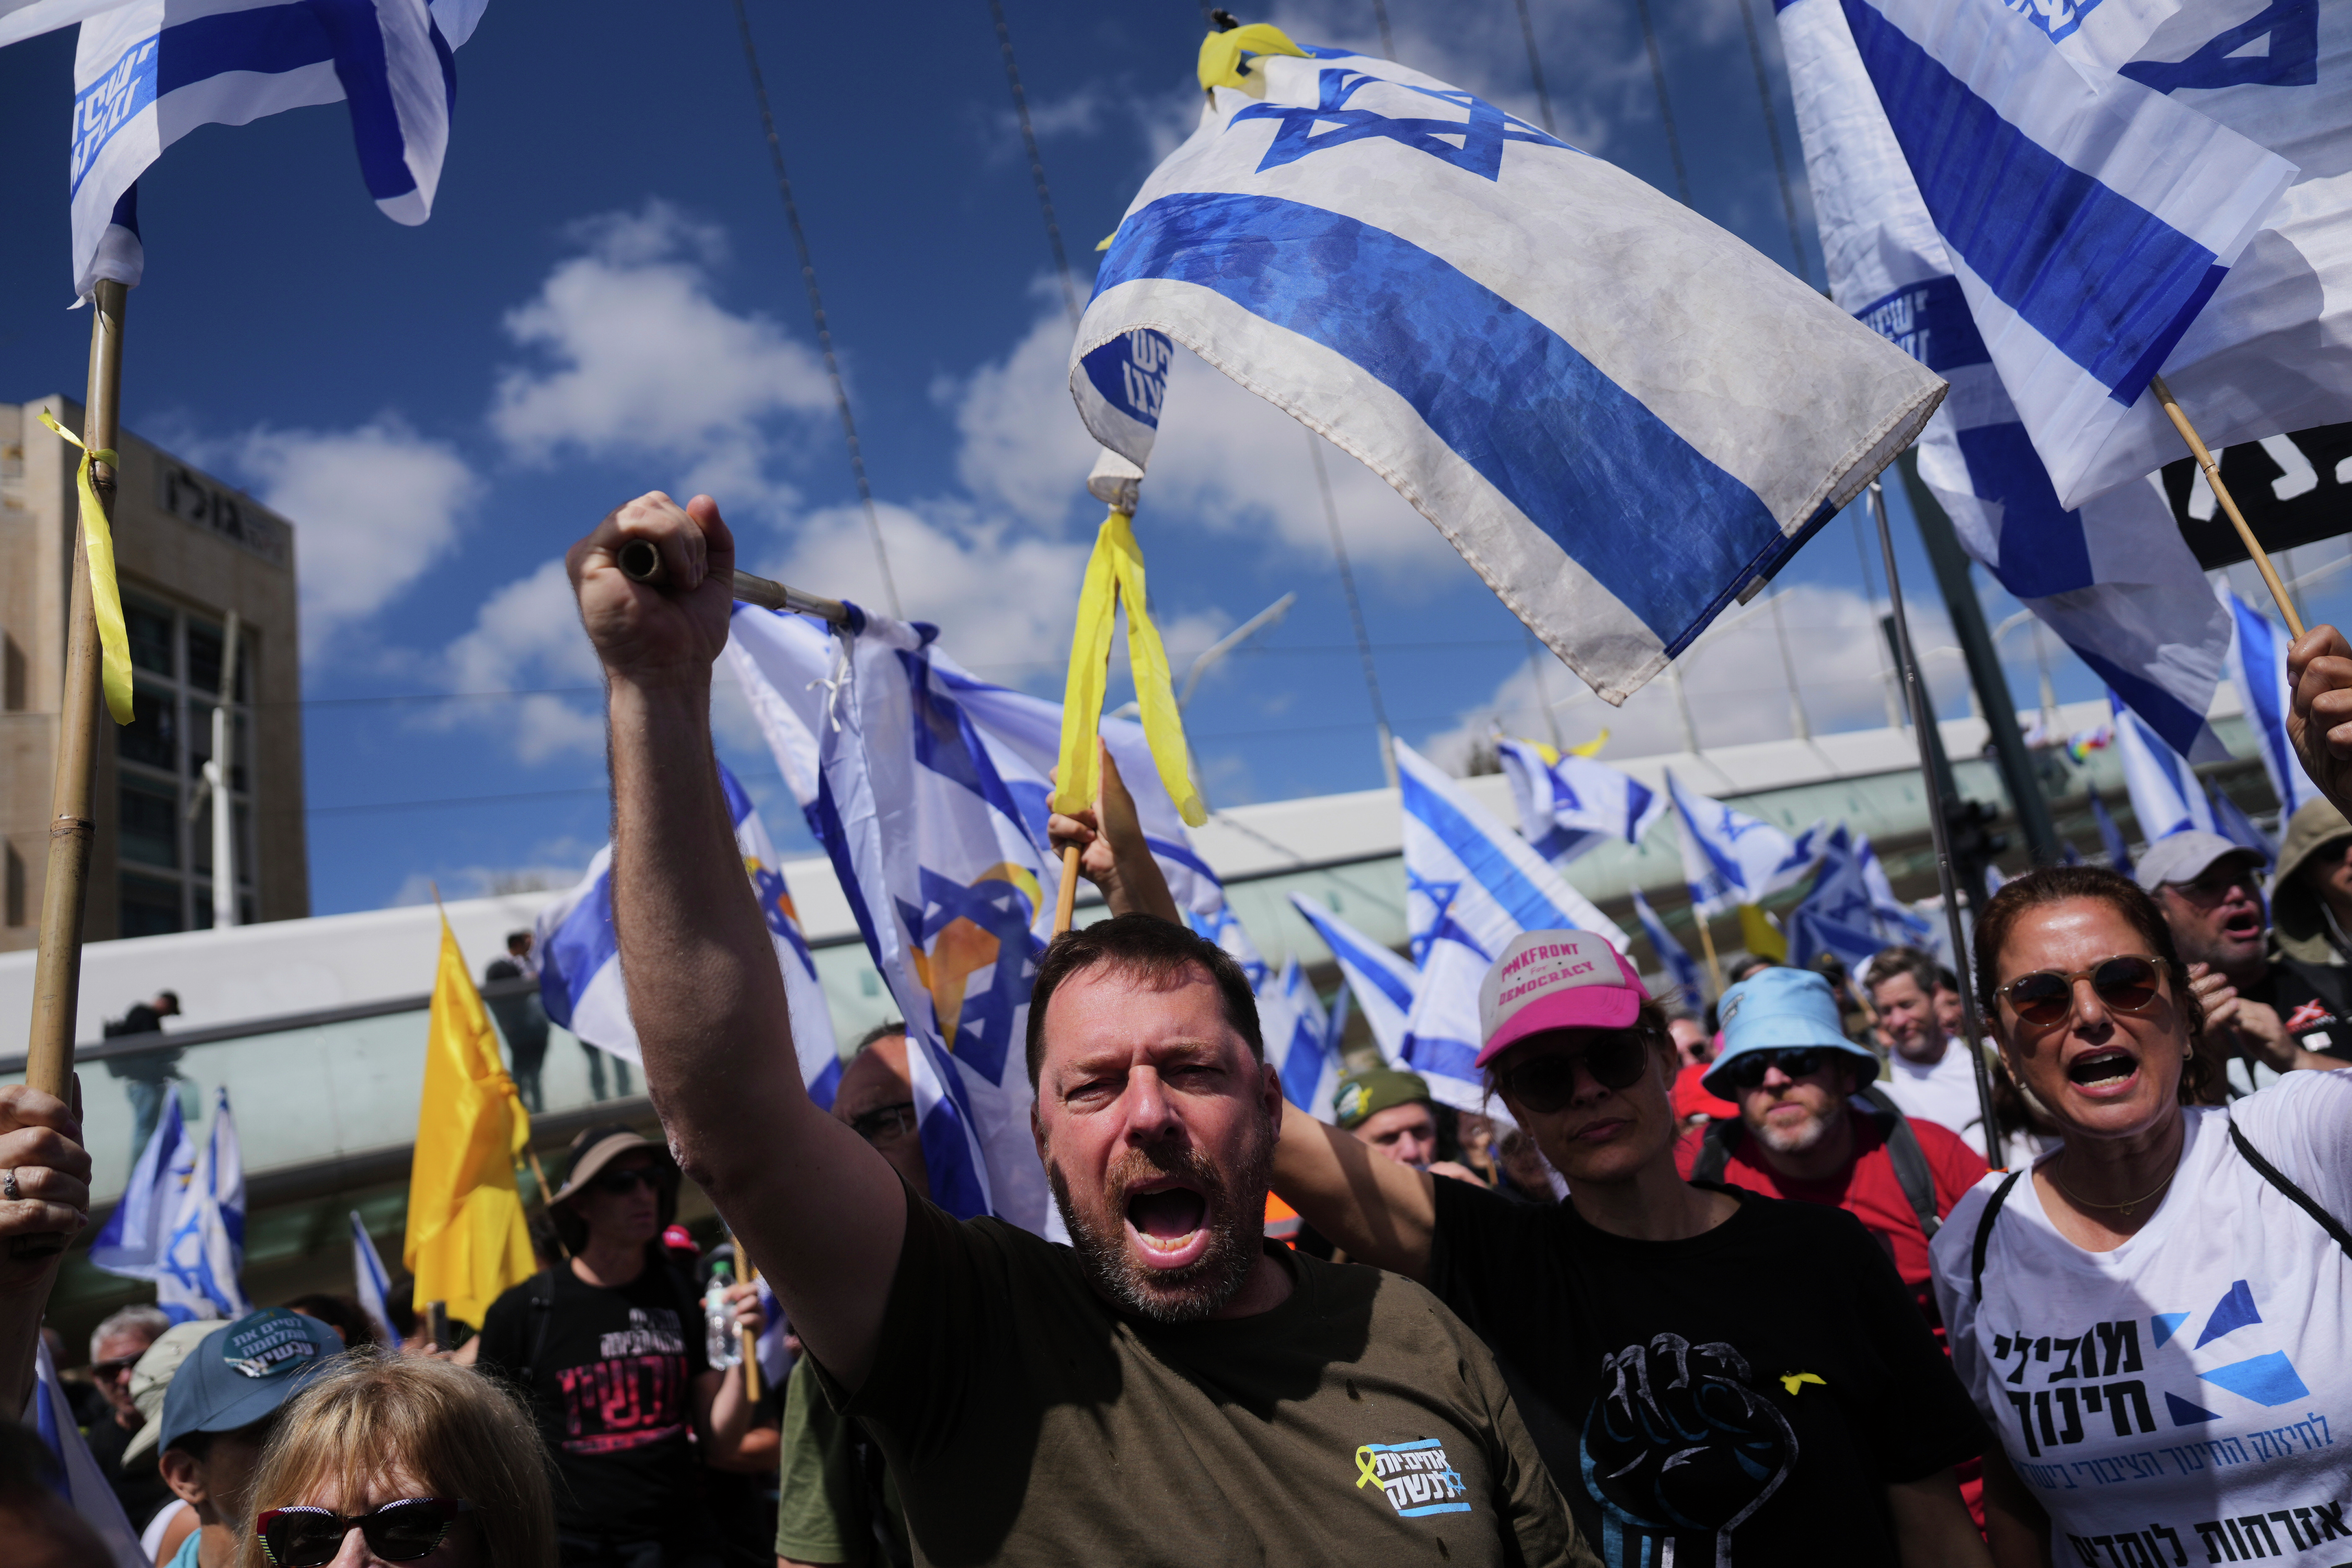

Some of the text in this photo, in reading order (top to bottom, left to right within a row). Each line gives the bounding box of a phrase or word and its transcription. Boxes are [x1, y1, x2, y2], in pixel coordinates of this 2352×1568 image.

[1498, 961, 1595, 1006] DEMOCRACY
[232, 1329, 259, 1347] את
[241, 1329, 308, 1357] המלחמה
[1993, 1320, 2144, 1385] מובילי
[2006, 1379, 2157, 1457] חינוך
[2247, 1412, 2334, 1463] לחיזוק
[2071, 1451, 2164, 1485] הציבורי
[2159, 1436, 2250, 1475] החינוך
[1383, 1470, 1455, 1510] לנשק
[2194, 1500, 2352, 1564] אזרחות
